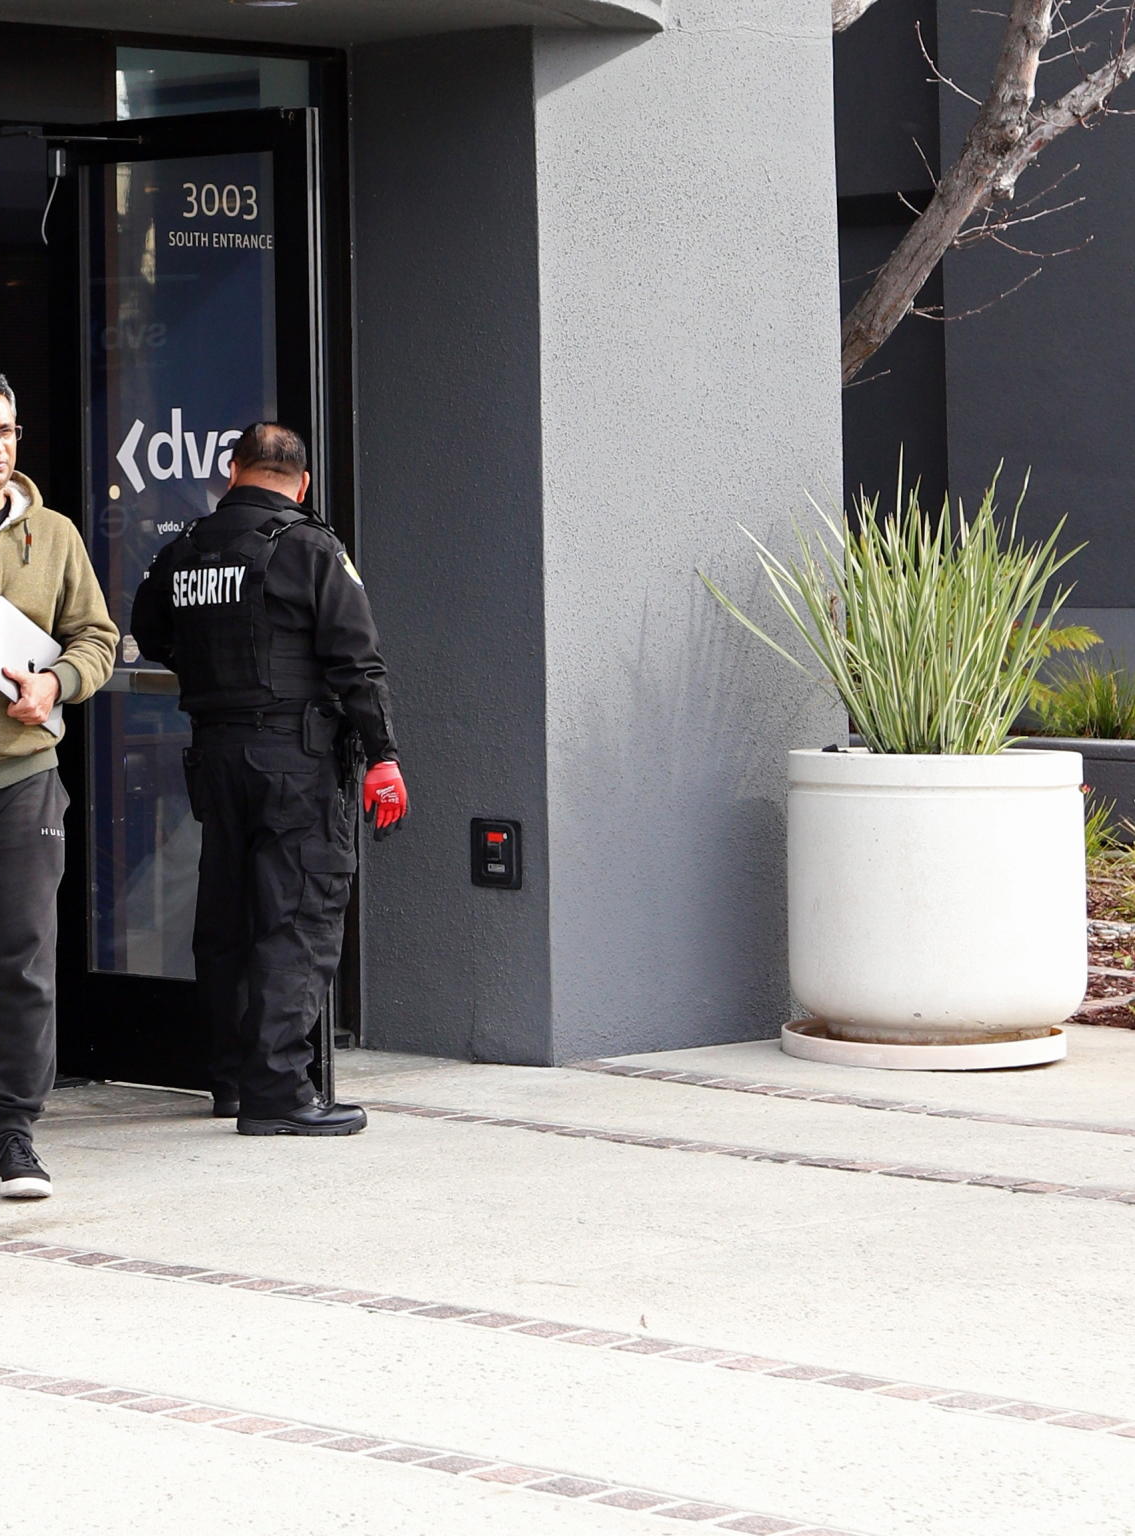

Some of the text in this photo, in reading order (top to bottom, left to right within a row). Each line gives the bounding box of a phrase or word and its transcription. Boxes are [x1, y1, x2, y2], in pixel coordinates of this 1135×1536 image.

[183, 182, 259, 221] 3003
[168, 231, 273, 250] SOUTH ENTRANCE
[172, 565, 246, 608] SECURITY
